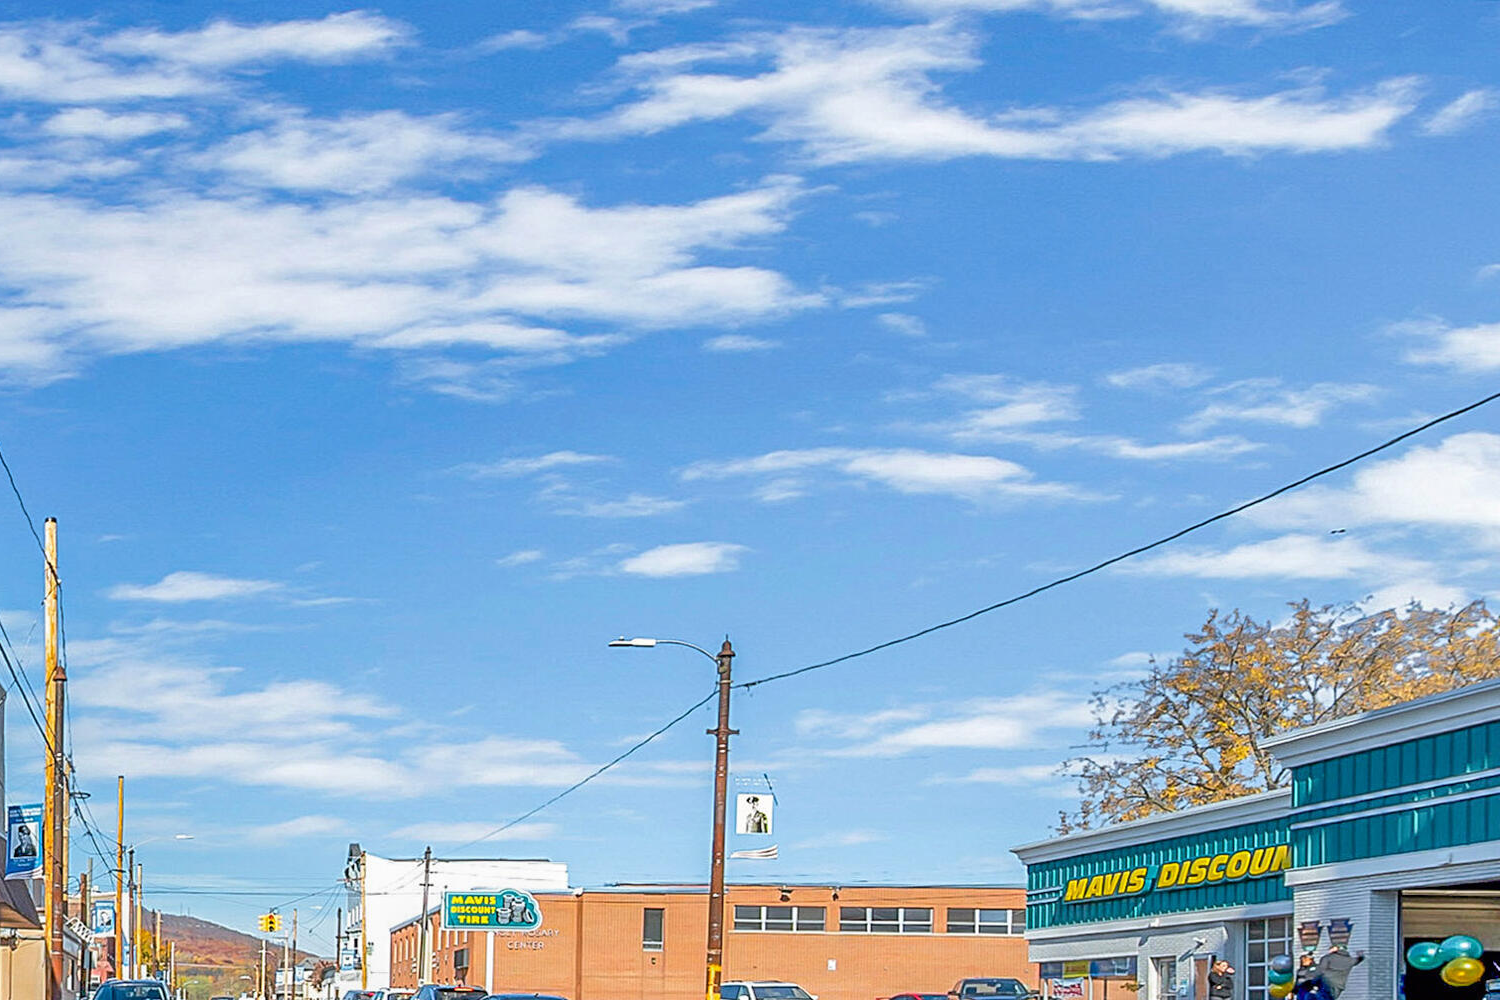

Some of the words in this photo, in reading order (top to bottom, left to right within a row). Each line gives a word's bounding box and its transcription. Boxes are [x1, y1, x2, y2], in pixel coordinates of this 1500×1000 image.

[1064, 867, 1148, 902] MAVIS
[452, 896, 496, 905] MAVIS
[451, 906, 496, 914] DISCOUNT
[458, 915, 489, 924] TIRE
[507, 941, 545, 950] CENTER
